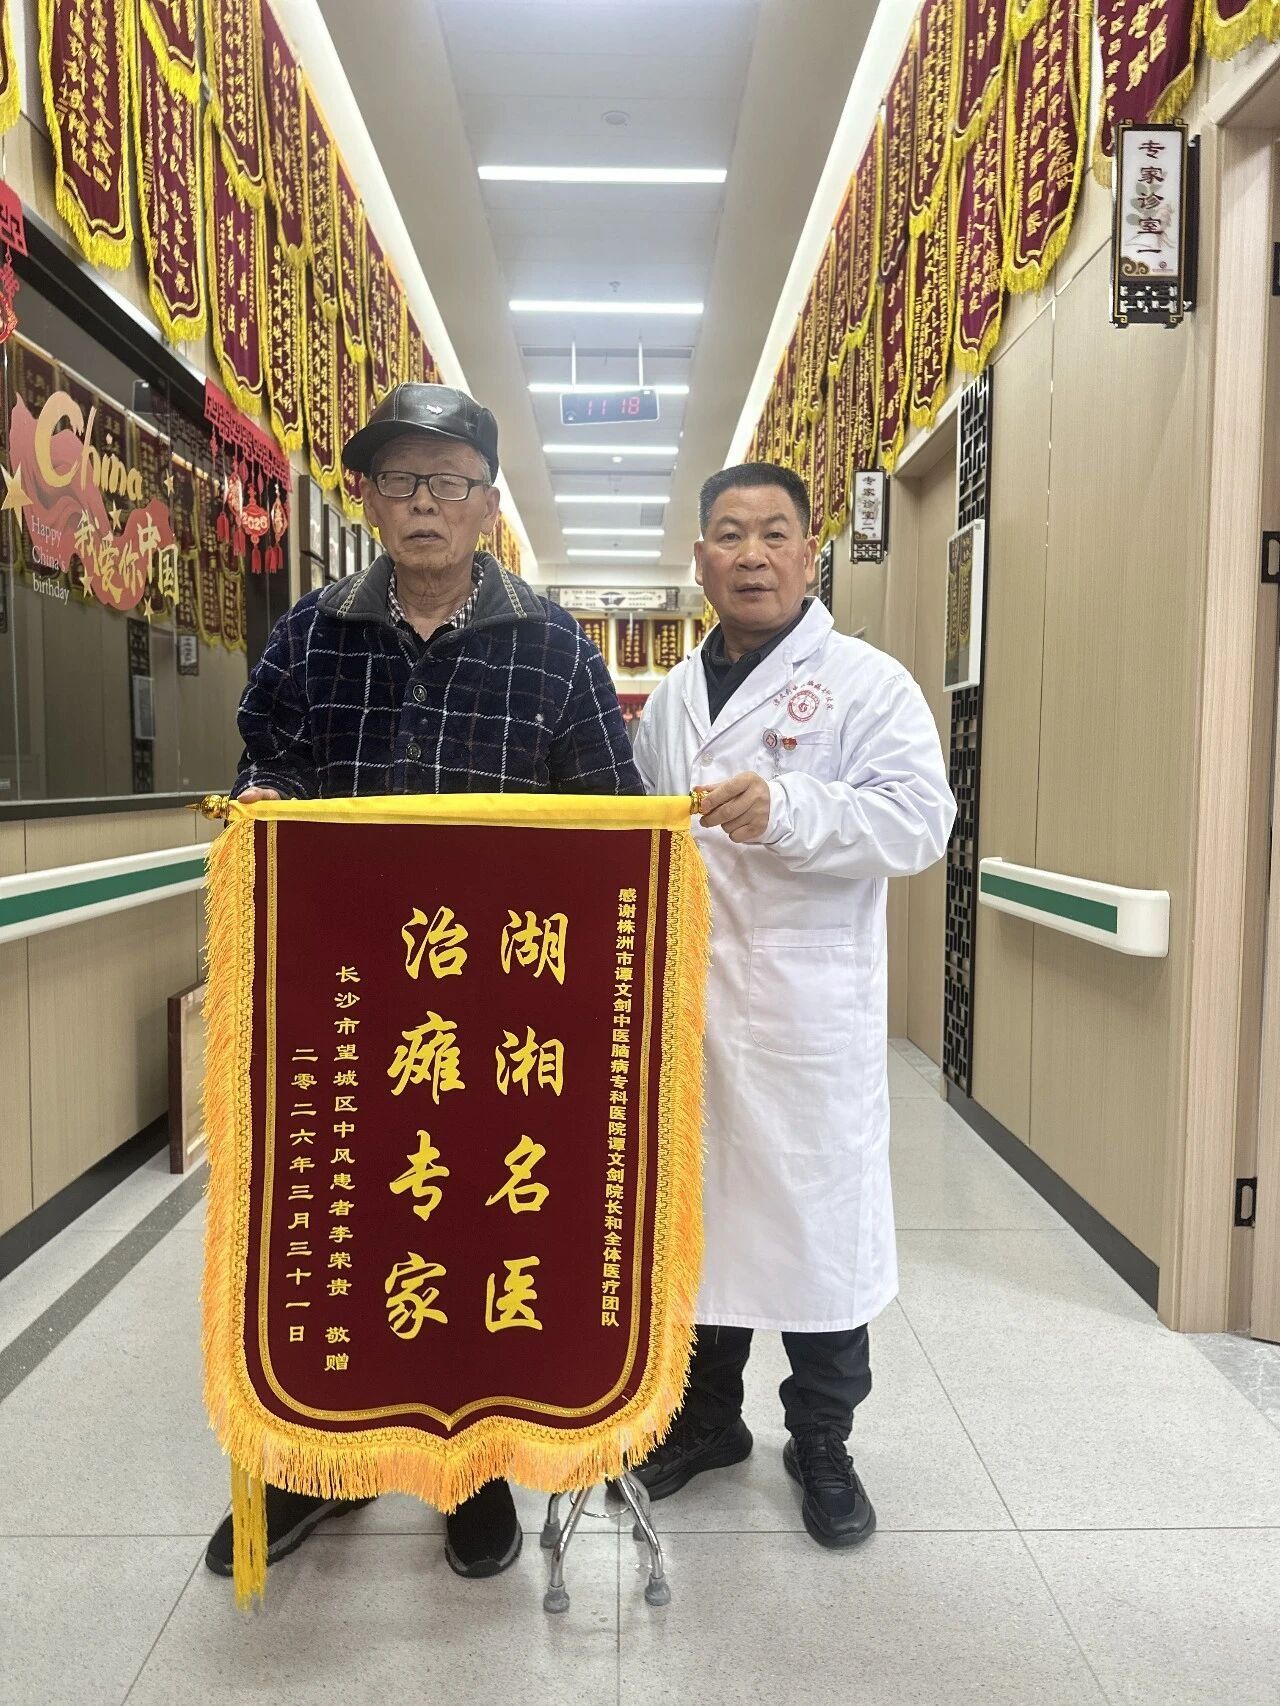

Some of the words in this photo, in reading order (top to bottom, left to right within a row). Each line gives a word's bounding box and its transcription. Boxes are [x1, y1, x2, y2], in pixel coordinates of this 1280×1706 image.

[1136, 139, 1166, 254] 专家诊室一
[35, 391, 143, 501] China
[31, 516, 62, 546] Happy
[31, 546, 66, 571] China's
[74, 509, 179, 605] 我爱你中国
[861, 476, 877, 531] 专家诊室二
[32, 574, 70, 605] birthday
[326, 966, 361, 1297] 长沙市望城区中风患者李荣贵
[385, 906, 468, 1340] 治瘫专家
[485, 910, 569, 1333] 湖湘名医
[601, 887, 637, 1329] 感谢株洲市谭文剑中医脑病专科医院谭文剑院长和全体医疗团队
[285, 1048, 319, 1345] 二零二六年三月三十一日
[324, 1326, 351, 1372] 敬赠
